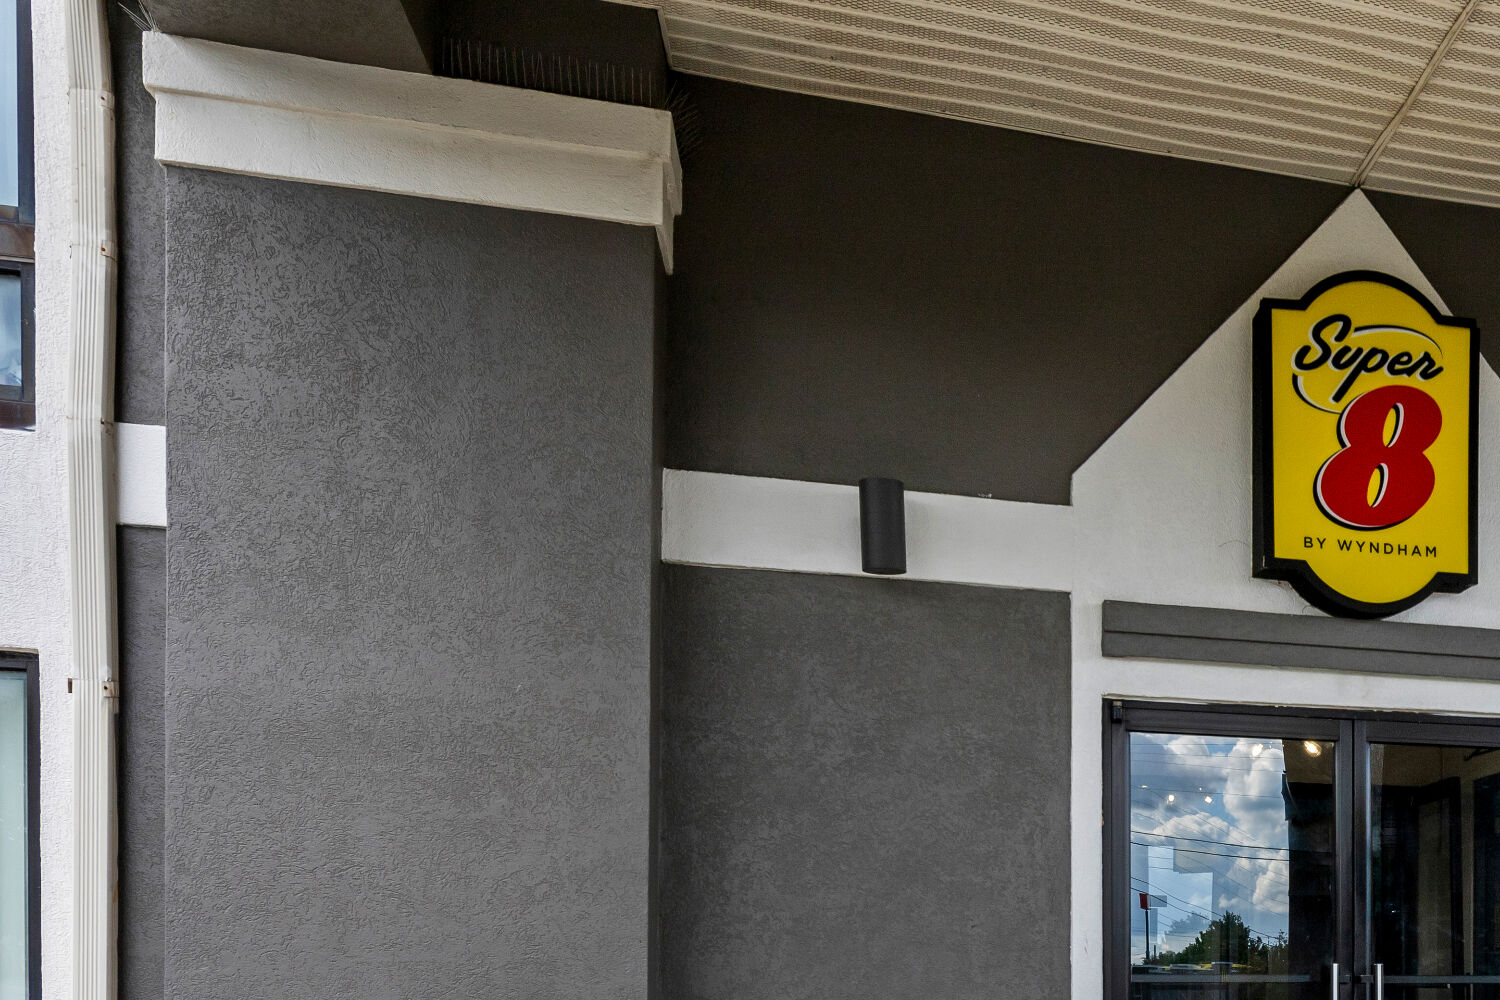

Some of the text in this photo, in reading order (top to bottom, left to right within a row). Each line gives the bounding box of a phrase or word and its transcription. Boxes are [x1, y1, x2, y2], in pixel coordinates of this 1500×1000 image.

[1292, 314, 1443, 404] Super
[1313, 385, 1443, 531] 8
[1304, 536, 1438, 557] BY WYNDHAM
